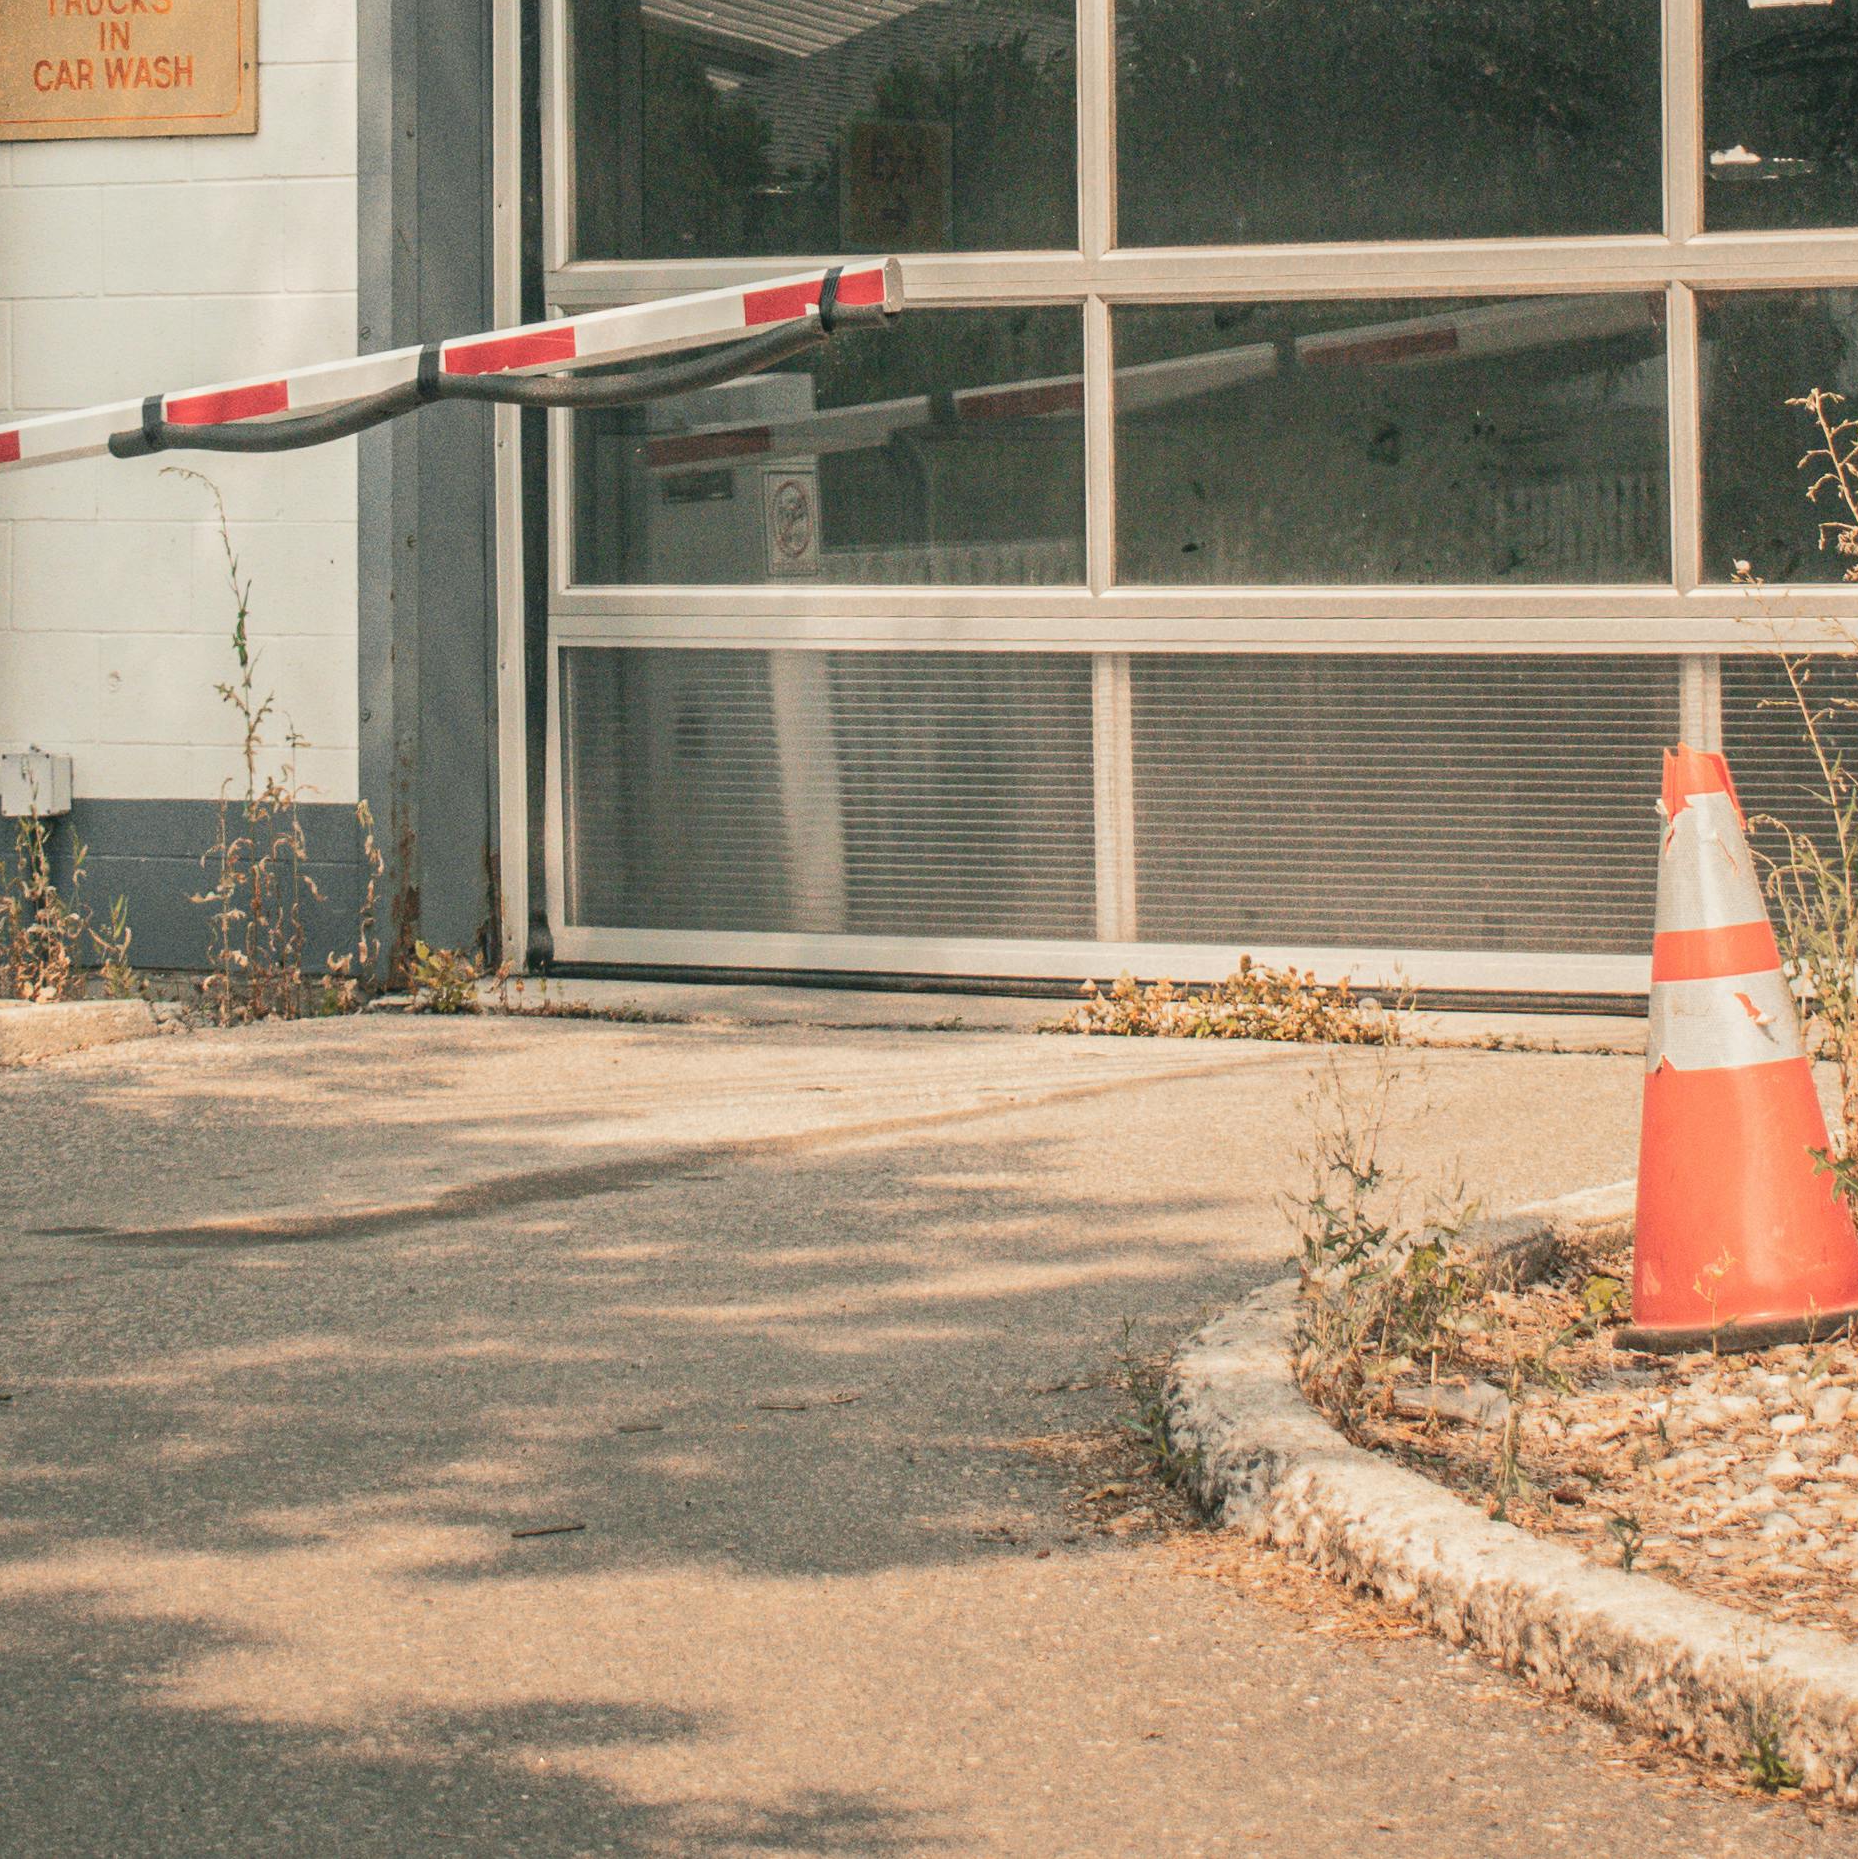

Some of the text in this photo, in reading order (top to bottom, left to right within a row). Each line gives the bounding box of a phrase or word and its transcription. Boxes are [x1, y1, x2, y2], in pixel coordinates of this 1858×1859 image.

[99, 21, 131, 51] IN
[34, 56, 193, 91] CAR WASH
